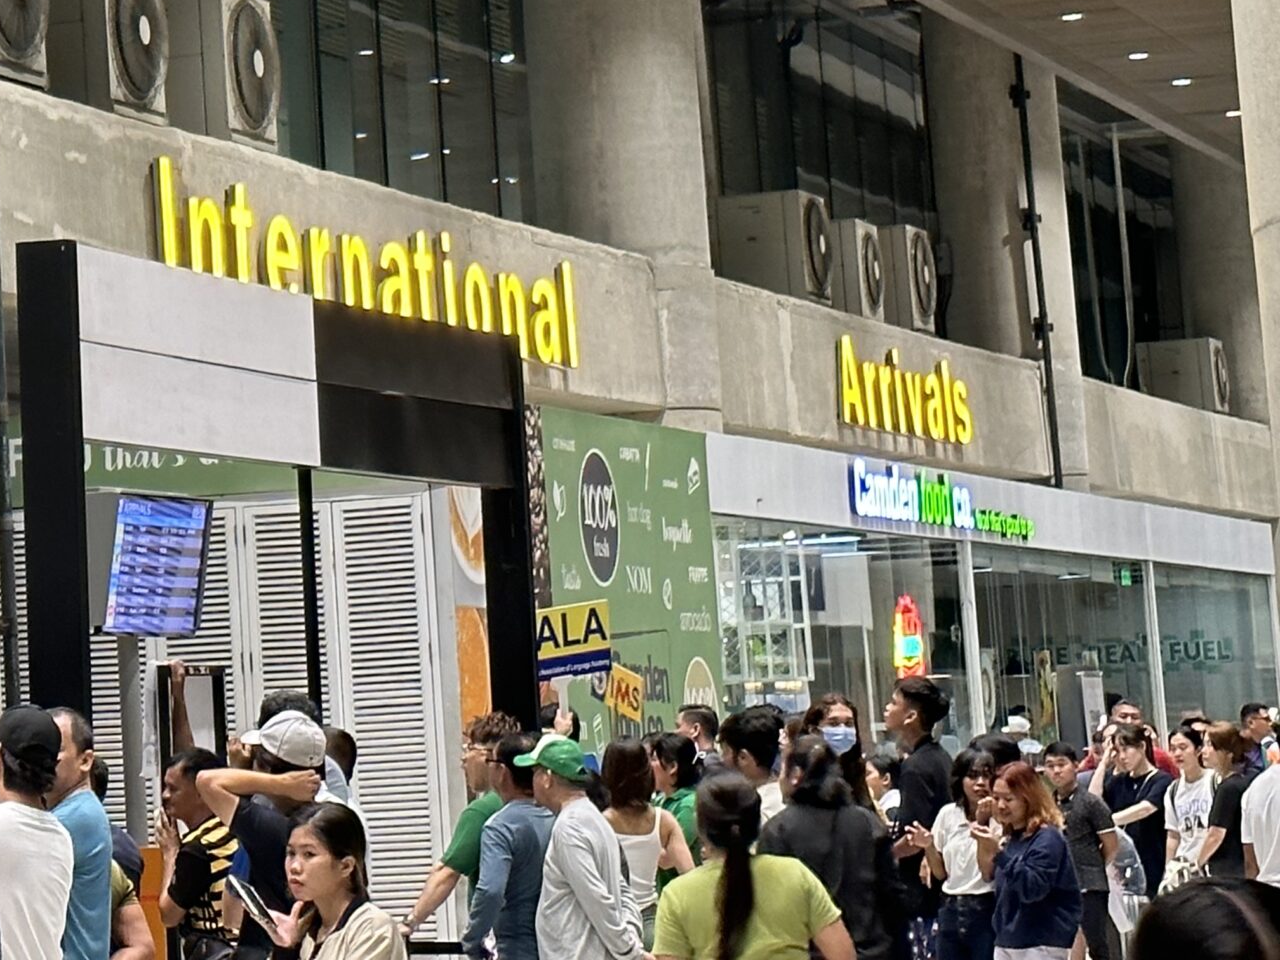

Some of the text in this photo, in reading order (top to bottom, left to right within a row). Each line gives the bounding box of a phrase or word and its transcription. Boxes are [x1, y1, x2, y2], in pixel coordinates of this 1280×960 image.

[154, 155, 578, 368] International
[839, 334, 972, 445] Arrivals
[583, 483, 617, 530] 100%
[853, 456, 919, 522] Camden
[921, 468, 953, 527] food
[593, 535, 610, 558] fresh
[626, 564, 652, 594] NOM
[537, 607, 608, 651] ALA
[1169, 638, 1232, 661] FUEL
